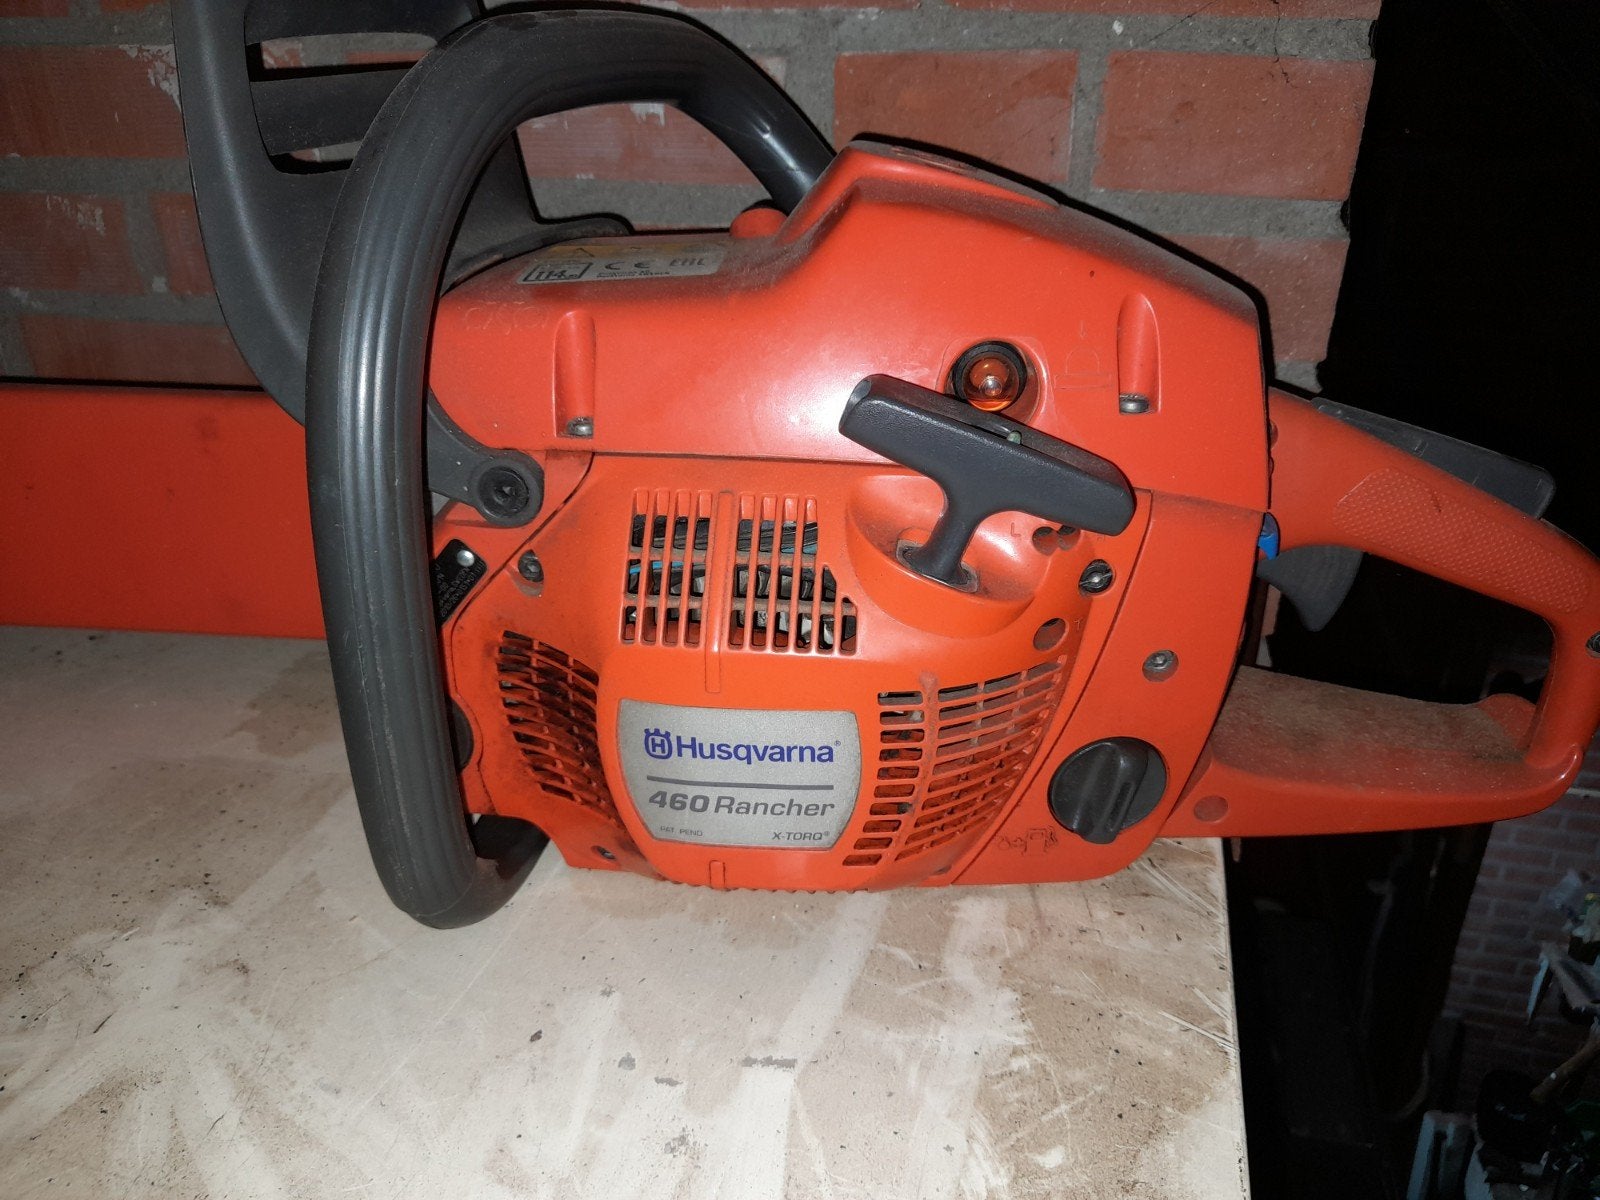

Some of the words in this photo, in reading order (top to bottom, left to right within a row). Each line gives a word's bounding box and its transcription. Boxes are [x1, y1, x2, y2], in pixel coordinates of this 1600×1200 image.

[676, 735, 835, 765] Husqvarna
[648, 790, 710, 814] 460
[714, 794, 836, 817] Rancher
